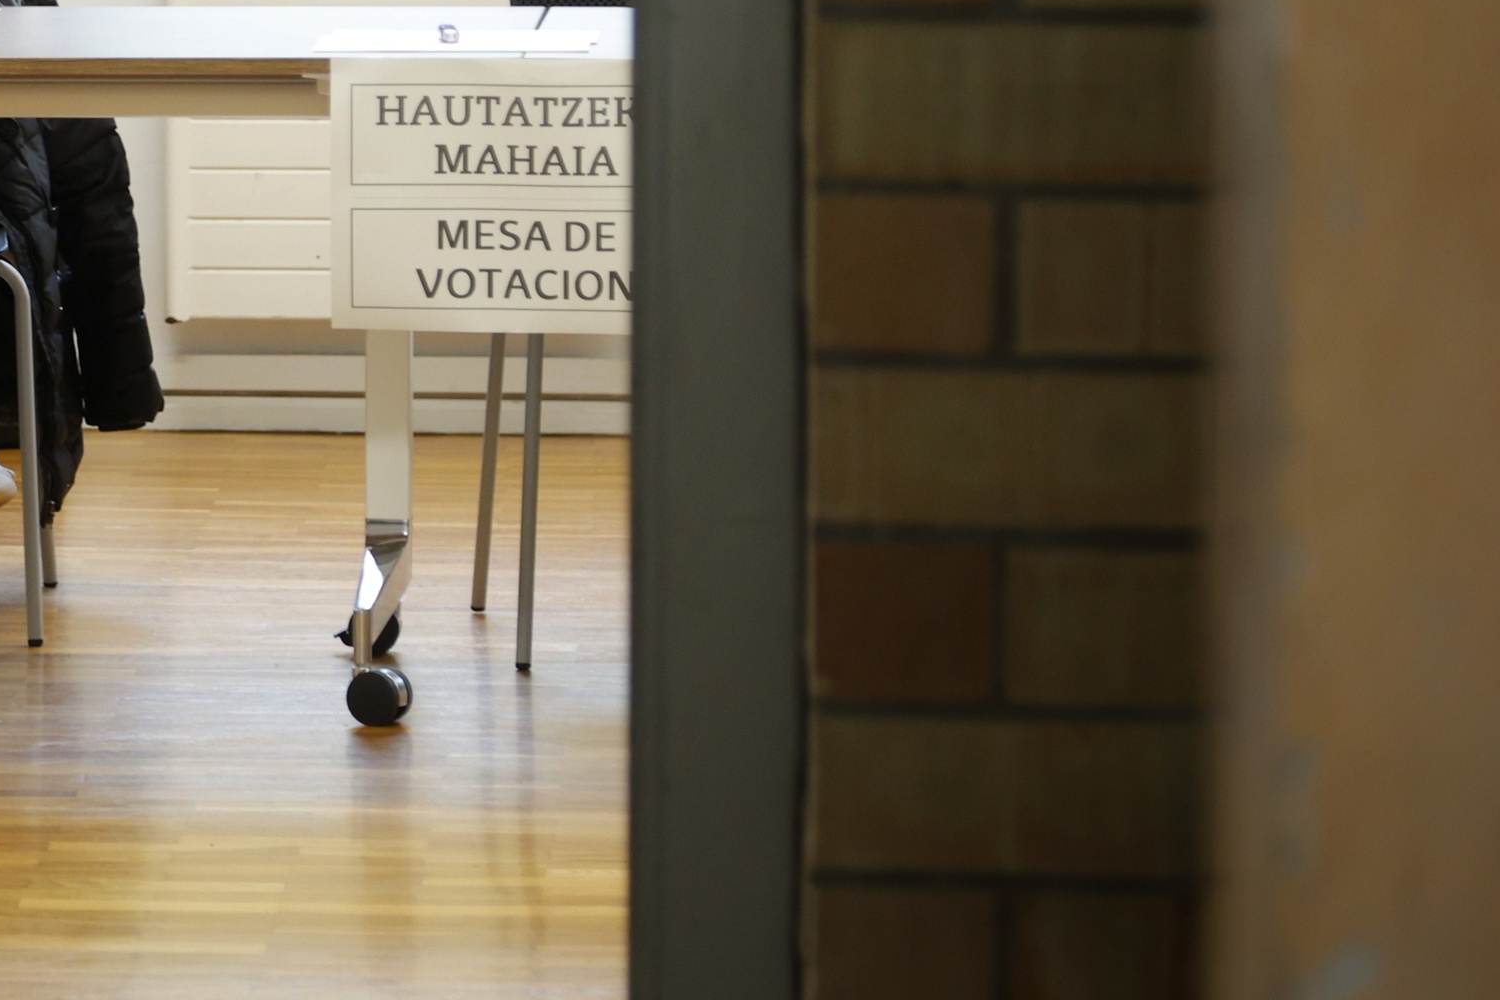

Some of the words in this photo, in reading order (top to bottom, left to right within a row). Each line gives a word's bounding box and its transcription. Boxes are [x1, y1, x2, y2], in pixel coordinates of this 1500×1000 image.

[434, 144, 619, 176] MAHAIA
[437, 220, 552, 251] MESA
[565, 221, 616, 252] DE
[416, 268, 635, 301] VOTACION
